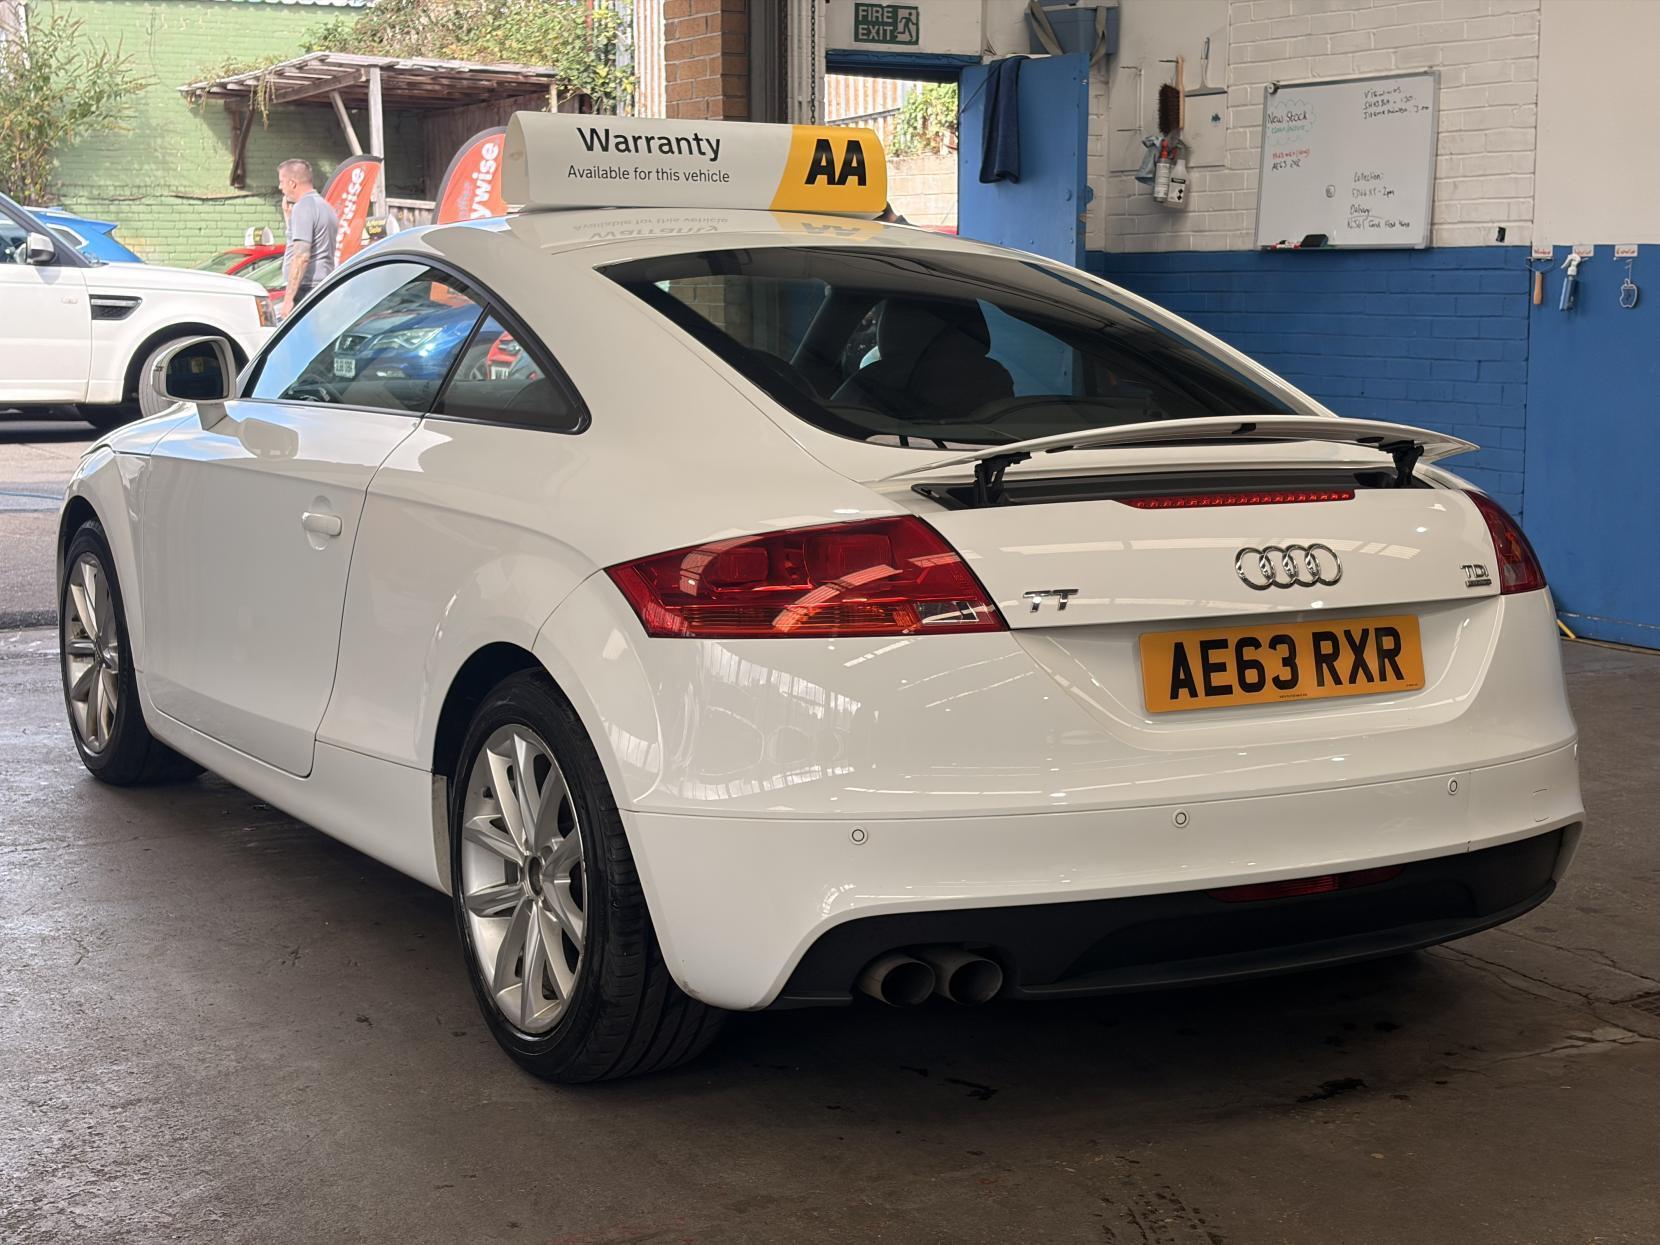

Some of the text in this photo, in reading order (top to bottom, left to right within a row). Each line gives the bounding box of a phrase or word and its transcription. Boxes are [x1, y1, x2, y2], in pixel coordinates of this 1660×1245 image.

[858, 6, 893, 22] FIRE
[858, 25, 893, 40] EXIT
[1267, 110, 1307, 124] New Stock
[576, 127, 721, 162] Warranty
[804, 138, 867, 187] AA
[567, 164, 730, 183] Available for this vehicle
[1460, 564, 1490, 579] TDI
[1022, 588, 1080, 613] TT
[1169, 626, 1405, 700] AE63 RXR
